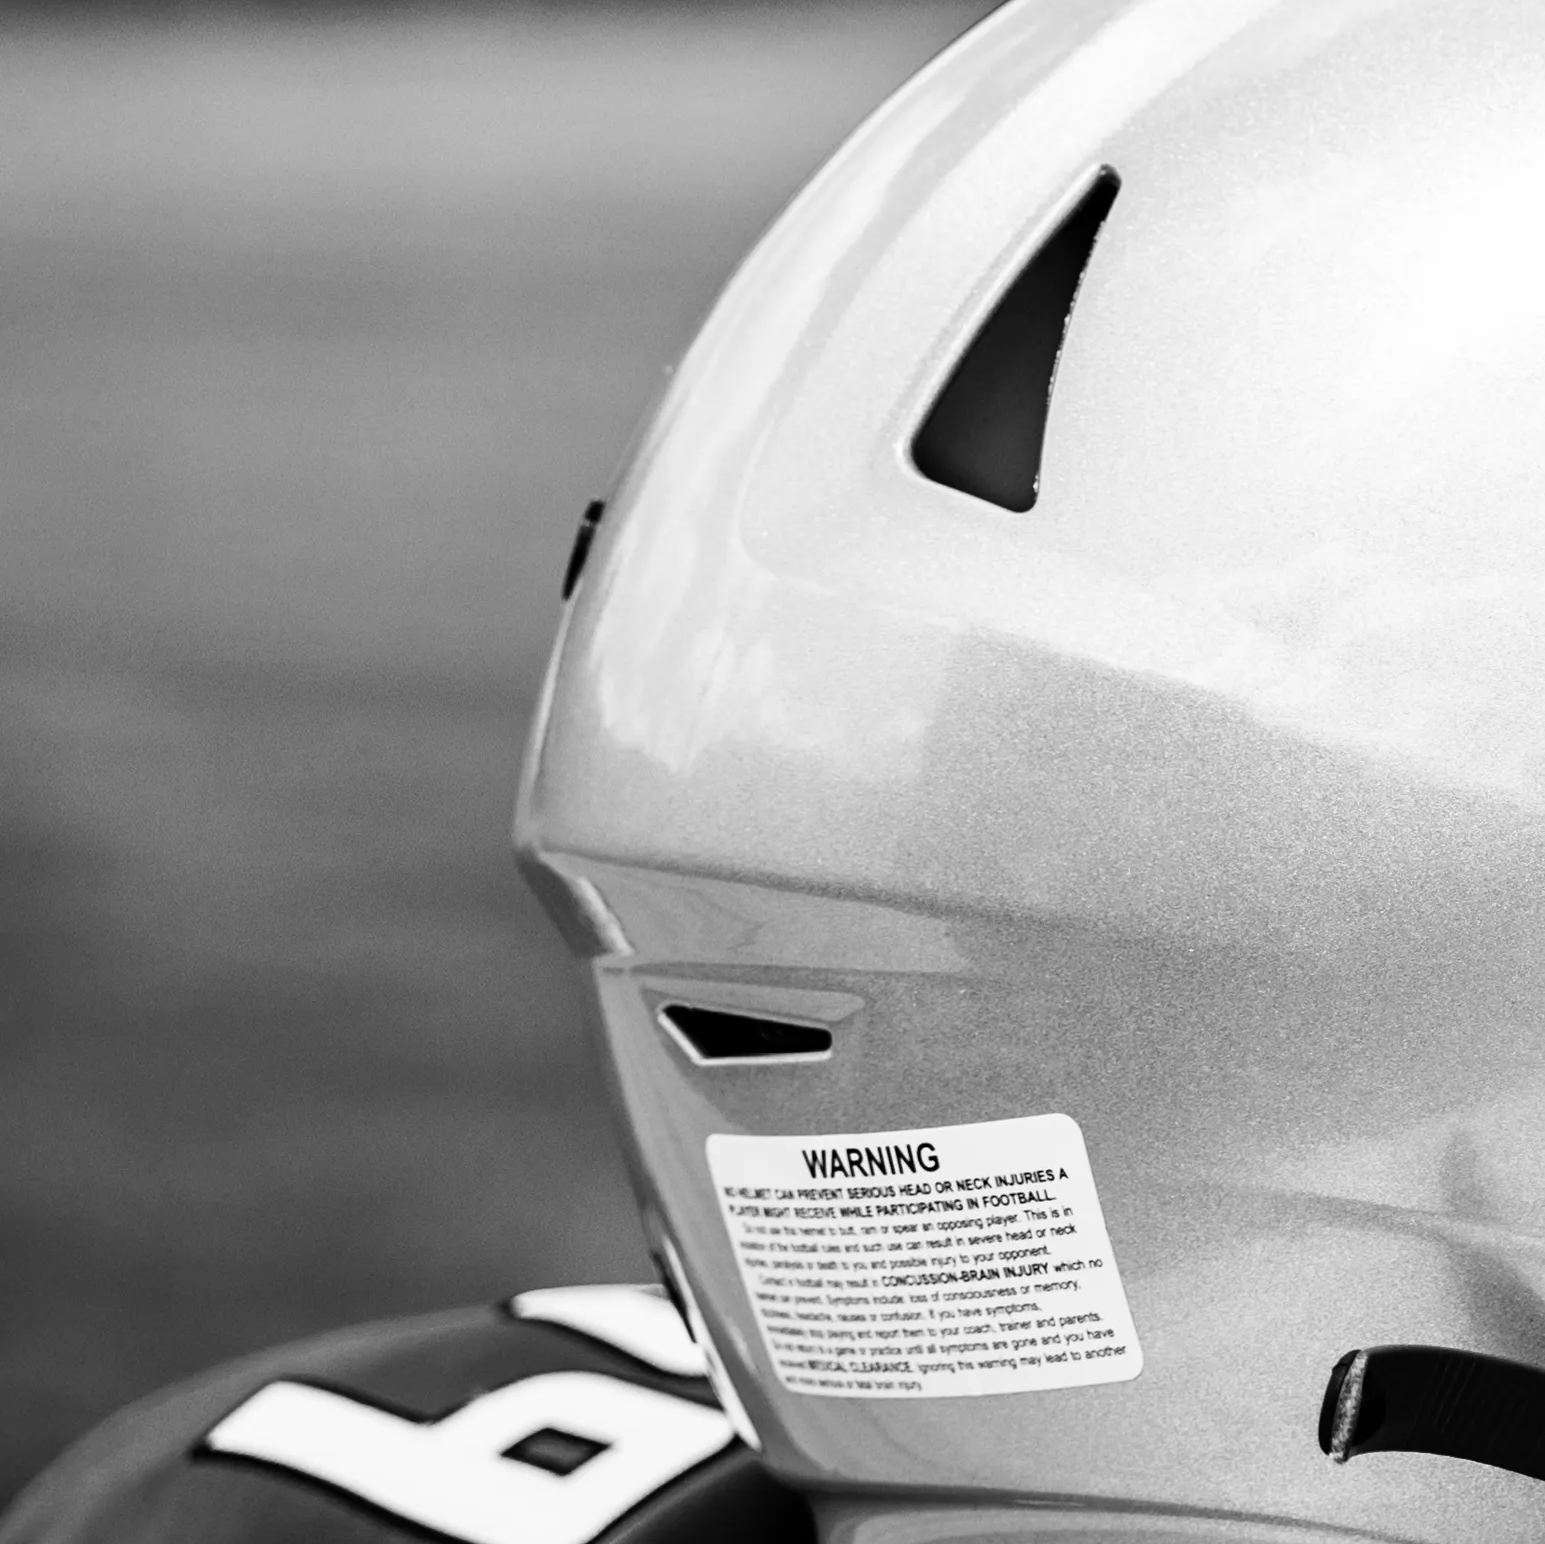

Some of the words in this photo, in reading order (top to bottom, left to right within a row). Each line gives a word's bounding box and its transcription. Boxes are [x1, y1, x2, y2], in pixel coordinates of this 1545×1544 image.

[802, 1143, 940, 1179] WARNING
[797, 1188, 843, 1201] PREVENT
[847, 1185, 896, 1200] SERIOUS
[899, 1183, 932, 1196] HEAD
[935, 1181, 954, 1194] OR
[956, 1177, 992, 1191] NECK
[995, 1169, 1055, 1187] INJURIES
[1059, 1168, 1069, 1180] A
[839, 1205, 873, 1218] WHILE
[875, 1199, 964, 1216] PARTICIPATING
[966, 1198, 980, 1210] IN
[982, 1189, 1056, 1207] FOOTBALL.
[937, 1218, 984, 1231] opposing
[1023, 1210, 1048, 1220] This
[1051, 1209, 1060, 1218] is
[1063, 1207, 1073, 1216] in
[926, 1237, 953, 1249] result
[956, 1238, 963, 1246] in
[968, 1234, 1003, 1246] severe
[1005, 1229, 1033, 1241] head
[1036, 1229, 1046, 1239] or
[1050, 1224, 1076, 1236] neck
[959, 1254, 970, 1264] to
[973, 1252, 994, 1265] your
[1003, 1262, 1048, 1278] INJURY
[1054, 1260, 1085, 1272] which
[1088, 1259, 1103, 1268] no
[943, 1287, 1017, 1301] consciousness
[1020, 1285, 1030, 1295] or
[957, 1308, 982, 1317] have
[999, 1321, 1031, 1332] trainer
[1036, 1317, 1056, 1329] and
[992, 1341, 1008, 1350] are
[1012, 1338, 1037, 1351] gone
[1041, 1334, 1061, 1346] and
[1065, 1334, 1084, 1346] you
[1086, 1329, 1114, 1339] have
[1019, 1357, 1041, 1367] may
[1045, 1351, 1068, 1363] lead
[1070, 1351, 1082, 1361] to
[1085, 1346, 1126, 1360] another
